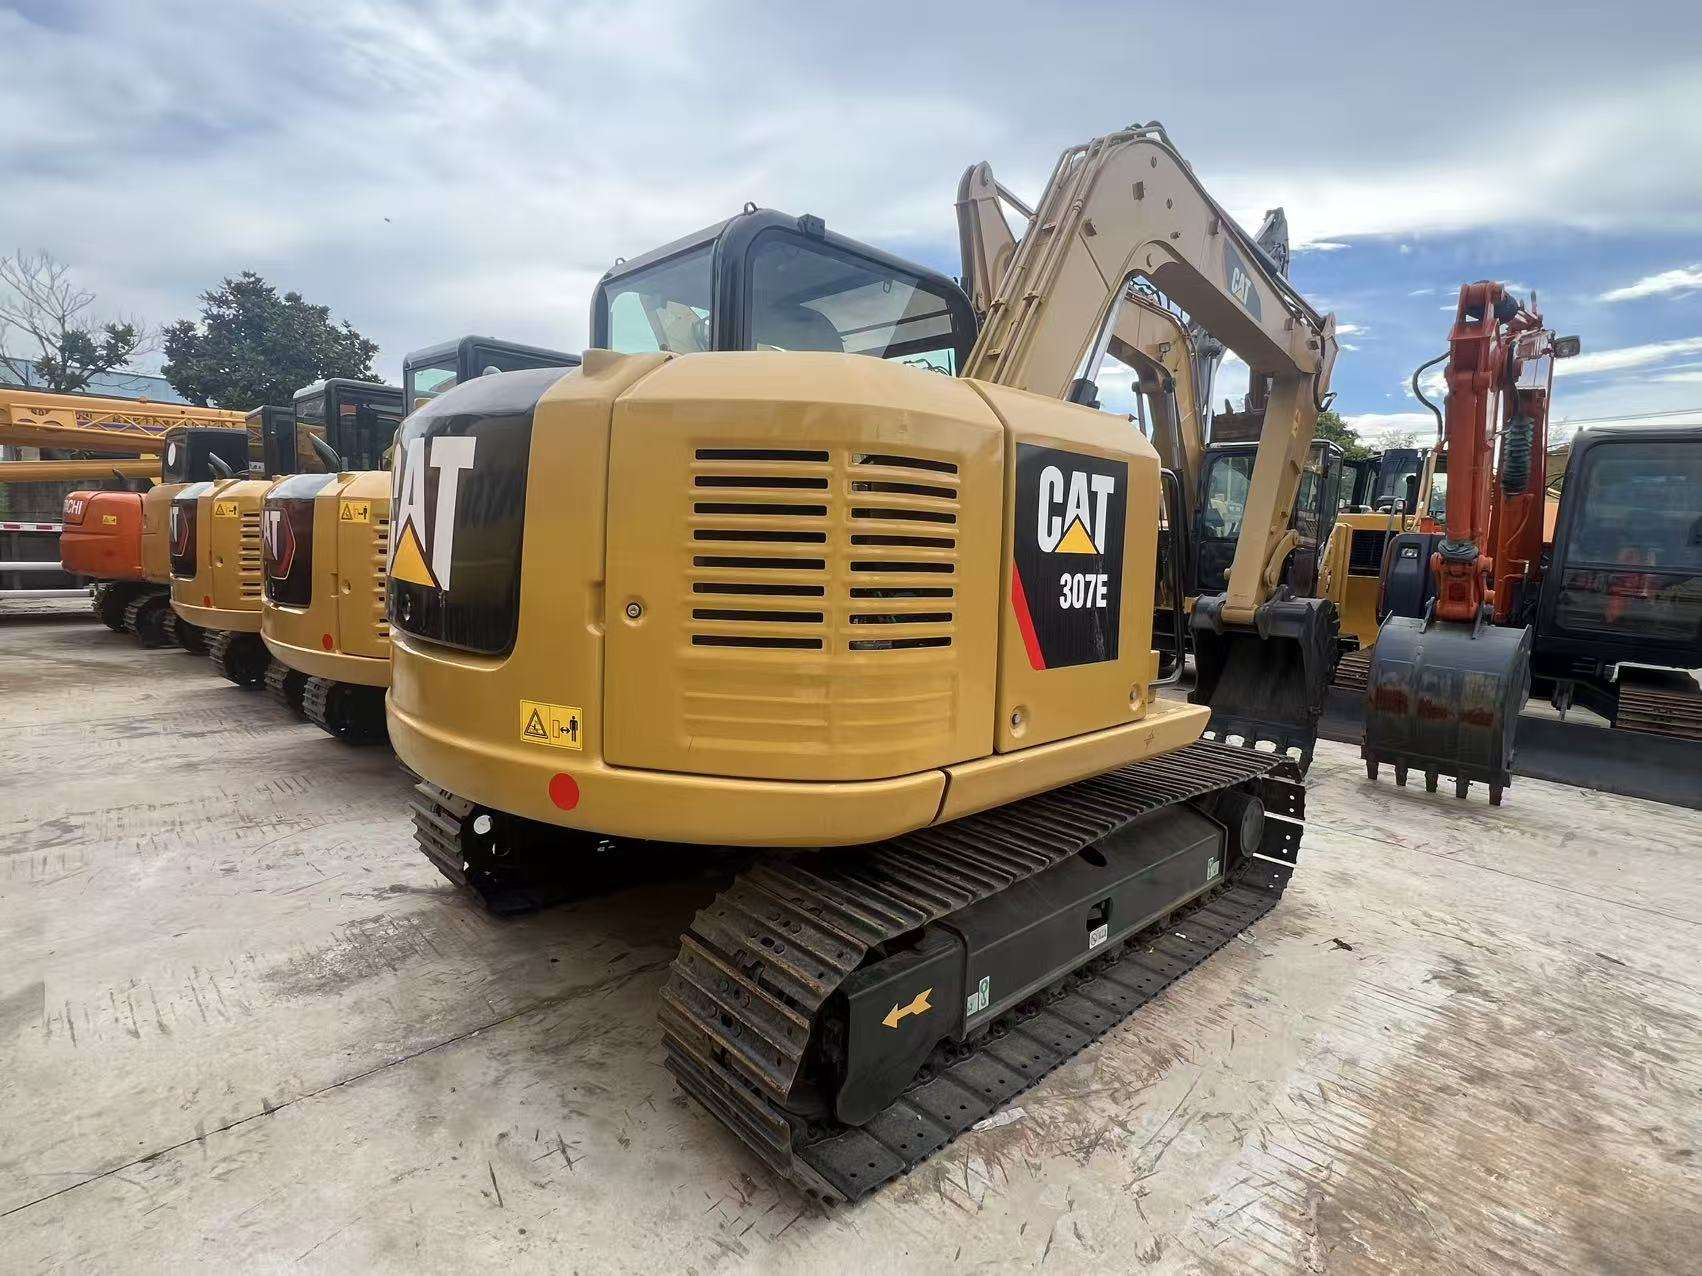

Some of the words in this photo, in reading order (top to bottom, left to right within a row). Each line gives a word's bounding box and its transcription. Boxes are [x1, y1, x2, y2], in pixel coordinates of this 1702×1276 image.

[1232, 267, 1251, 305] CAT
[1037, 465, 1115, 555] CAT
[1059, 572, 1108, 609] 307E
